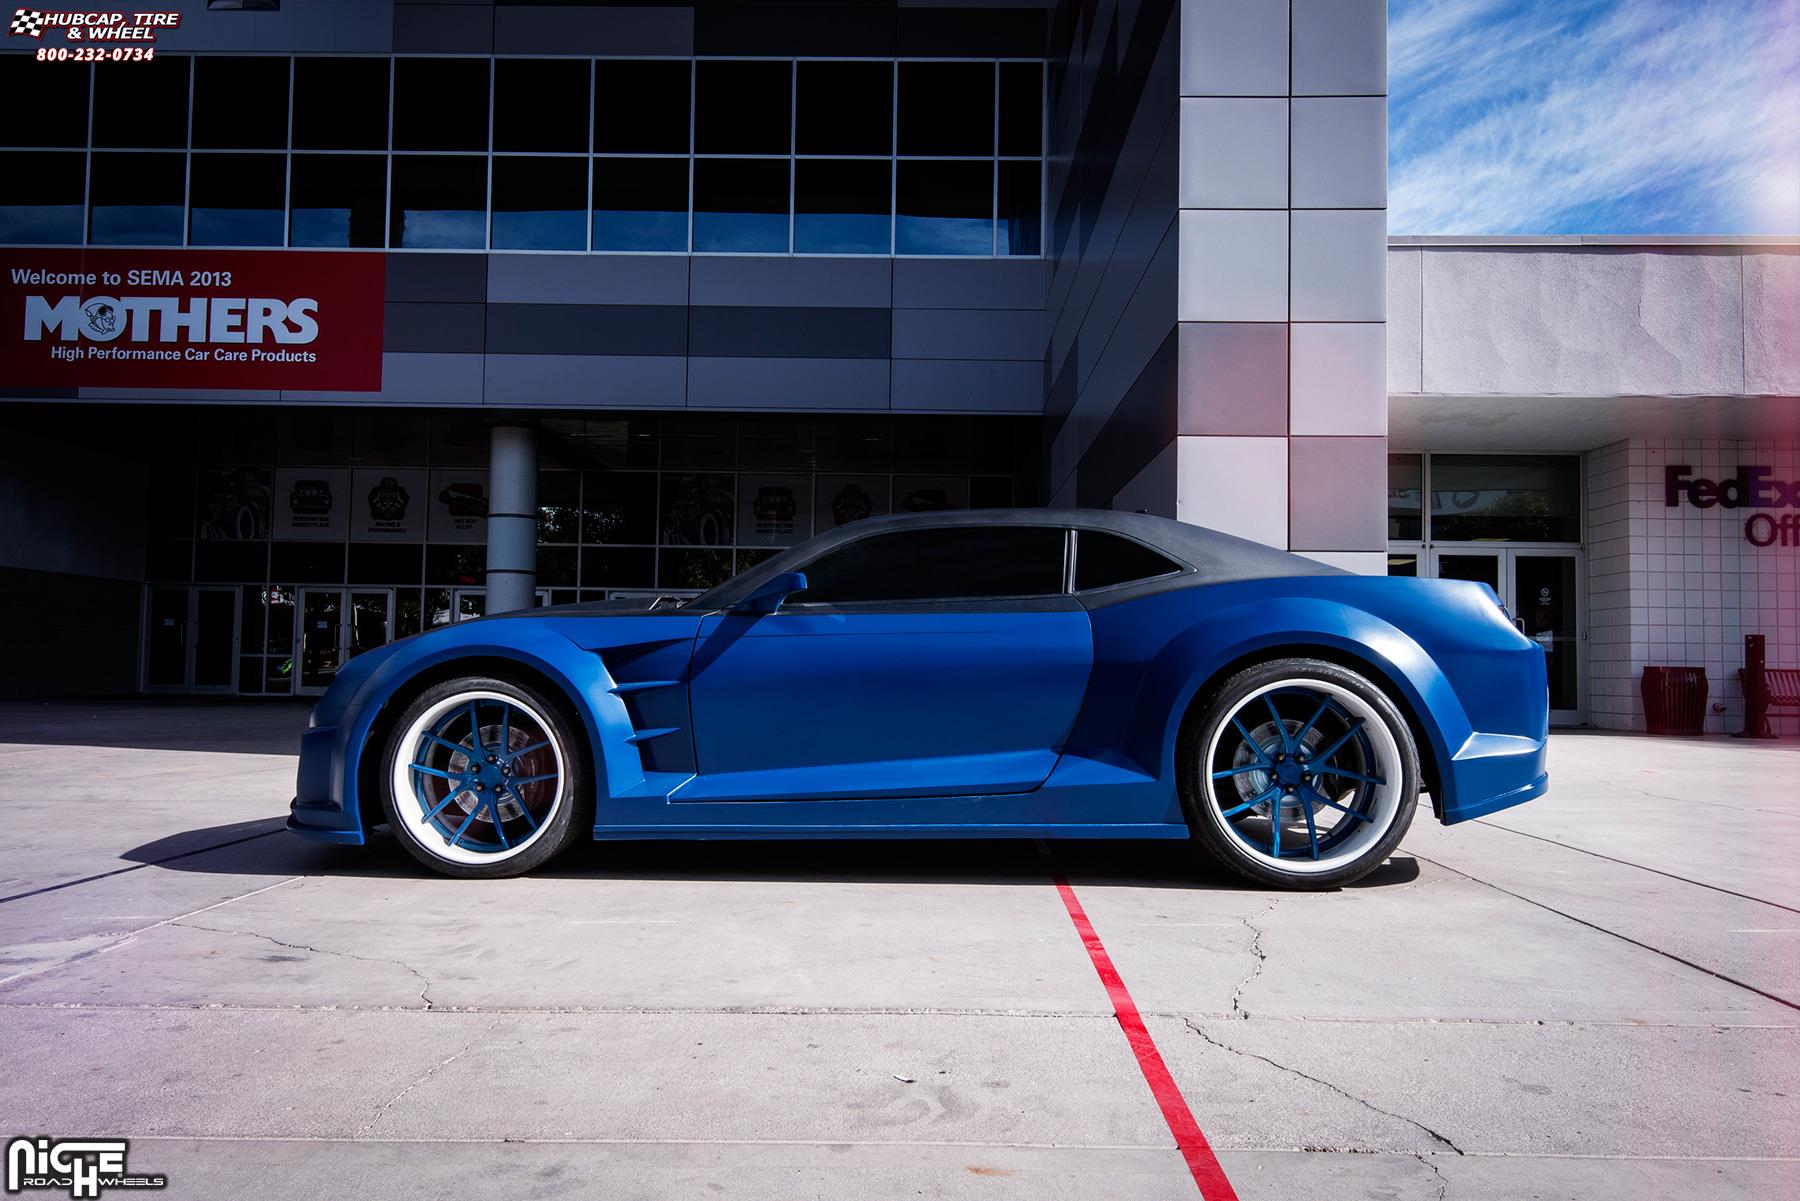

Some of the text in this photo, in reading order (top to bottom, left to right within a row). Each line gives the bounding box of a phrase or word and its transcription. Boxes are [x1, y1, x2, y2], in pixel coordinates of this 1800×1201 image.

[11, 268, 233, 287] Welcome to SEMA 2013
[24, 295, 319, 345] MOTHERS
[51, 346, 317, 363] High Performance Car Care Products
[1665, 465, 1800, 509] FedEx
